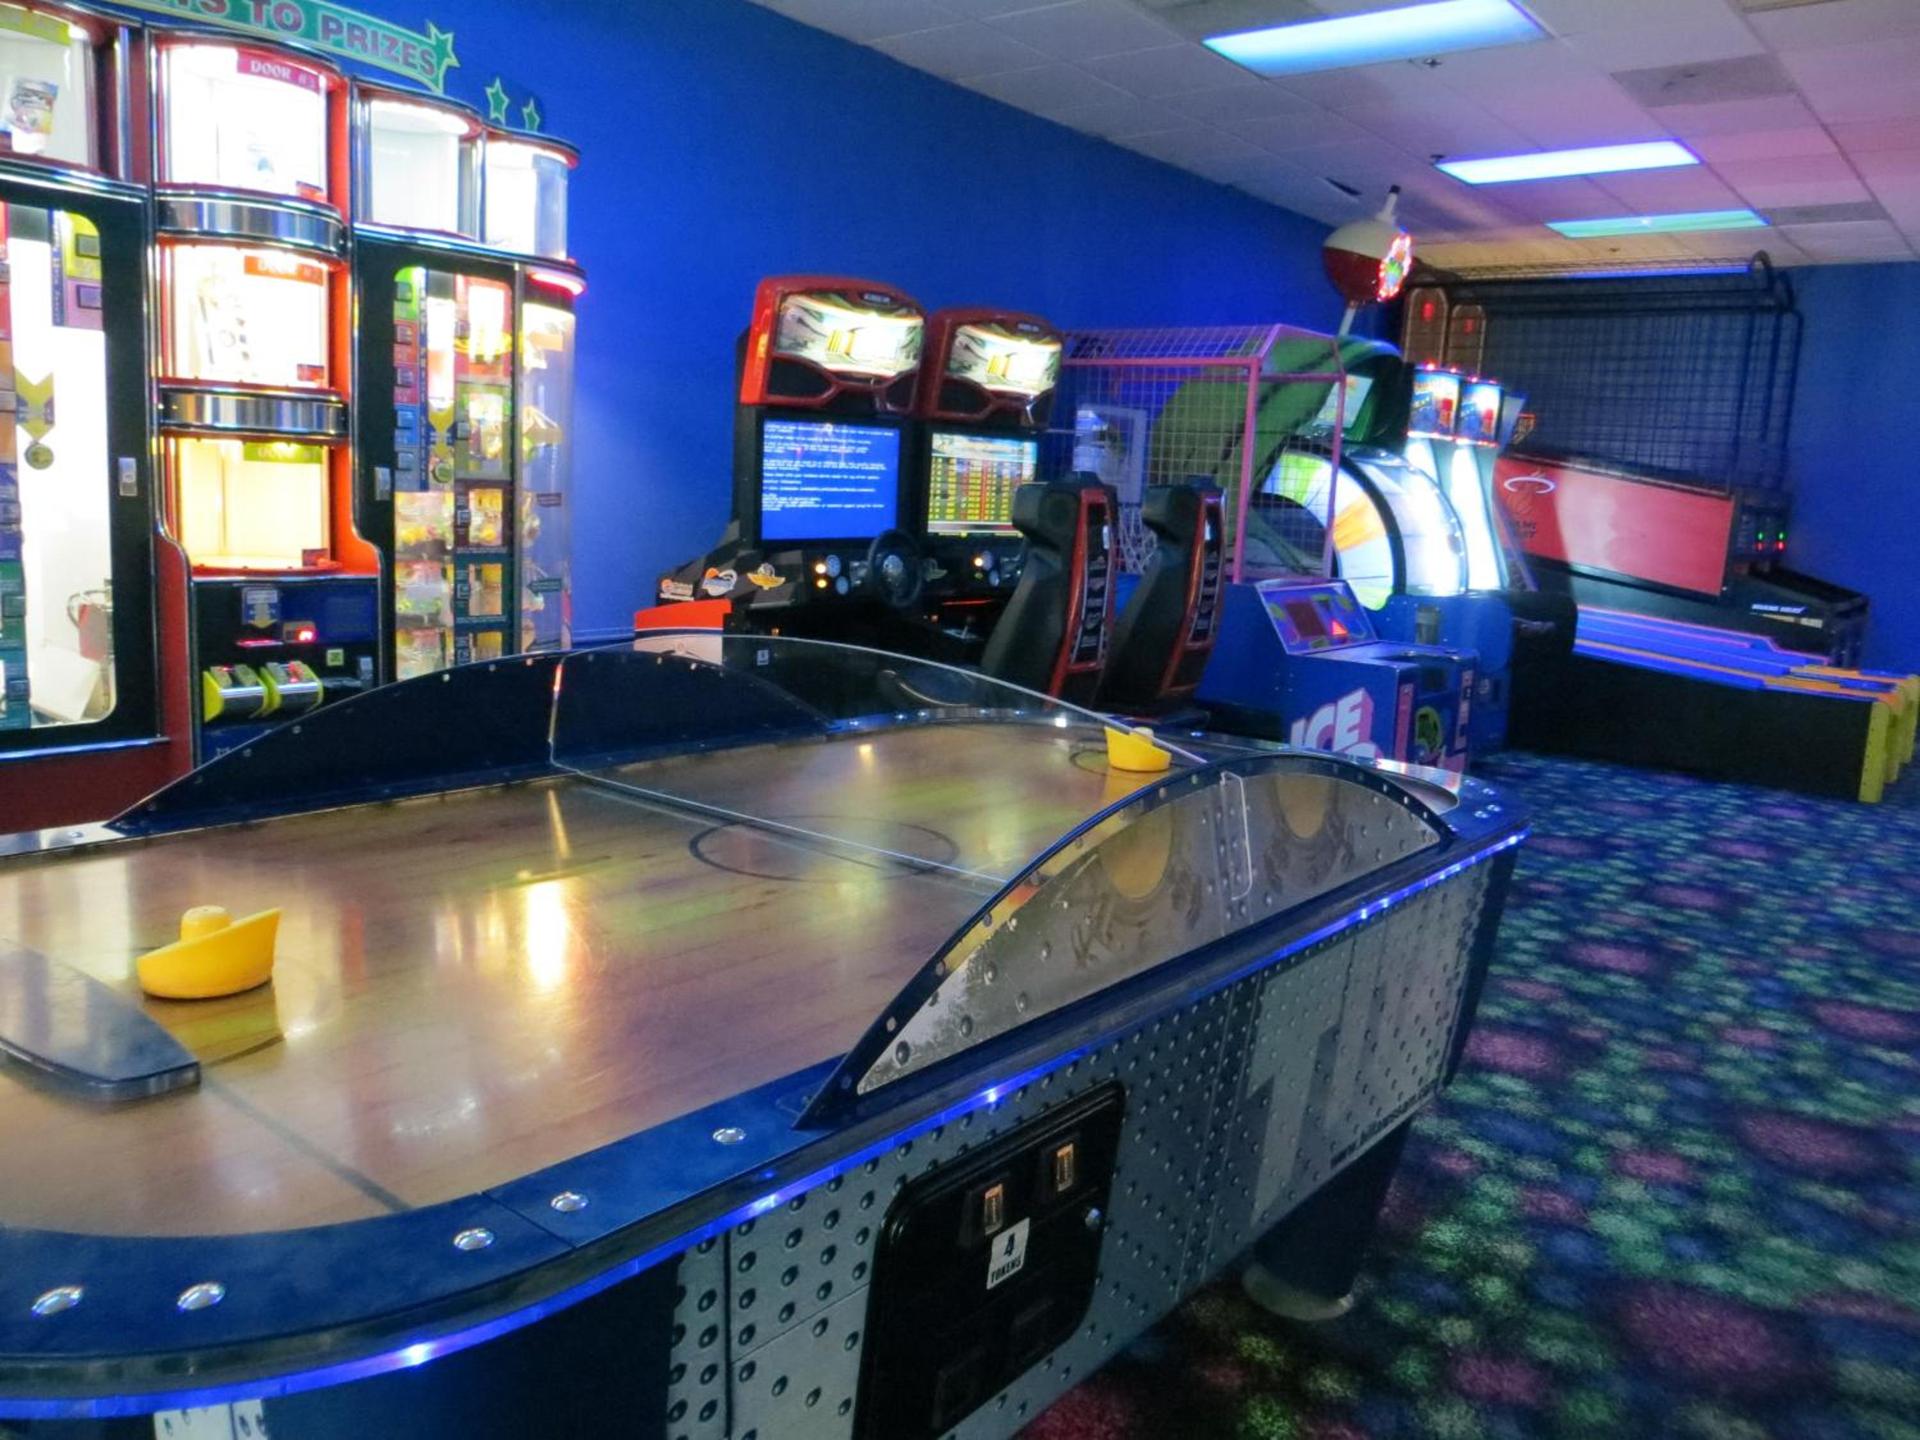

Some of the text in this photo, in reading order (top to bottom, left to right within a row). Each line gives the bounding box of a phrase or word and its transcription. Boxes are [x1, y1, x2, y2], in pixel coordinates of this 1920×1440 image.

[251, 0, 435, 76] TO PRIZES
[251, 60, 291, 80] DOOR
[1291, 688, 1365, 751] ICE
[1003, 1232, 1015, 1257] 4
[991, 1257, 1021, 1283] TOKENS
